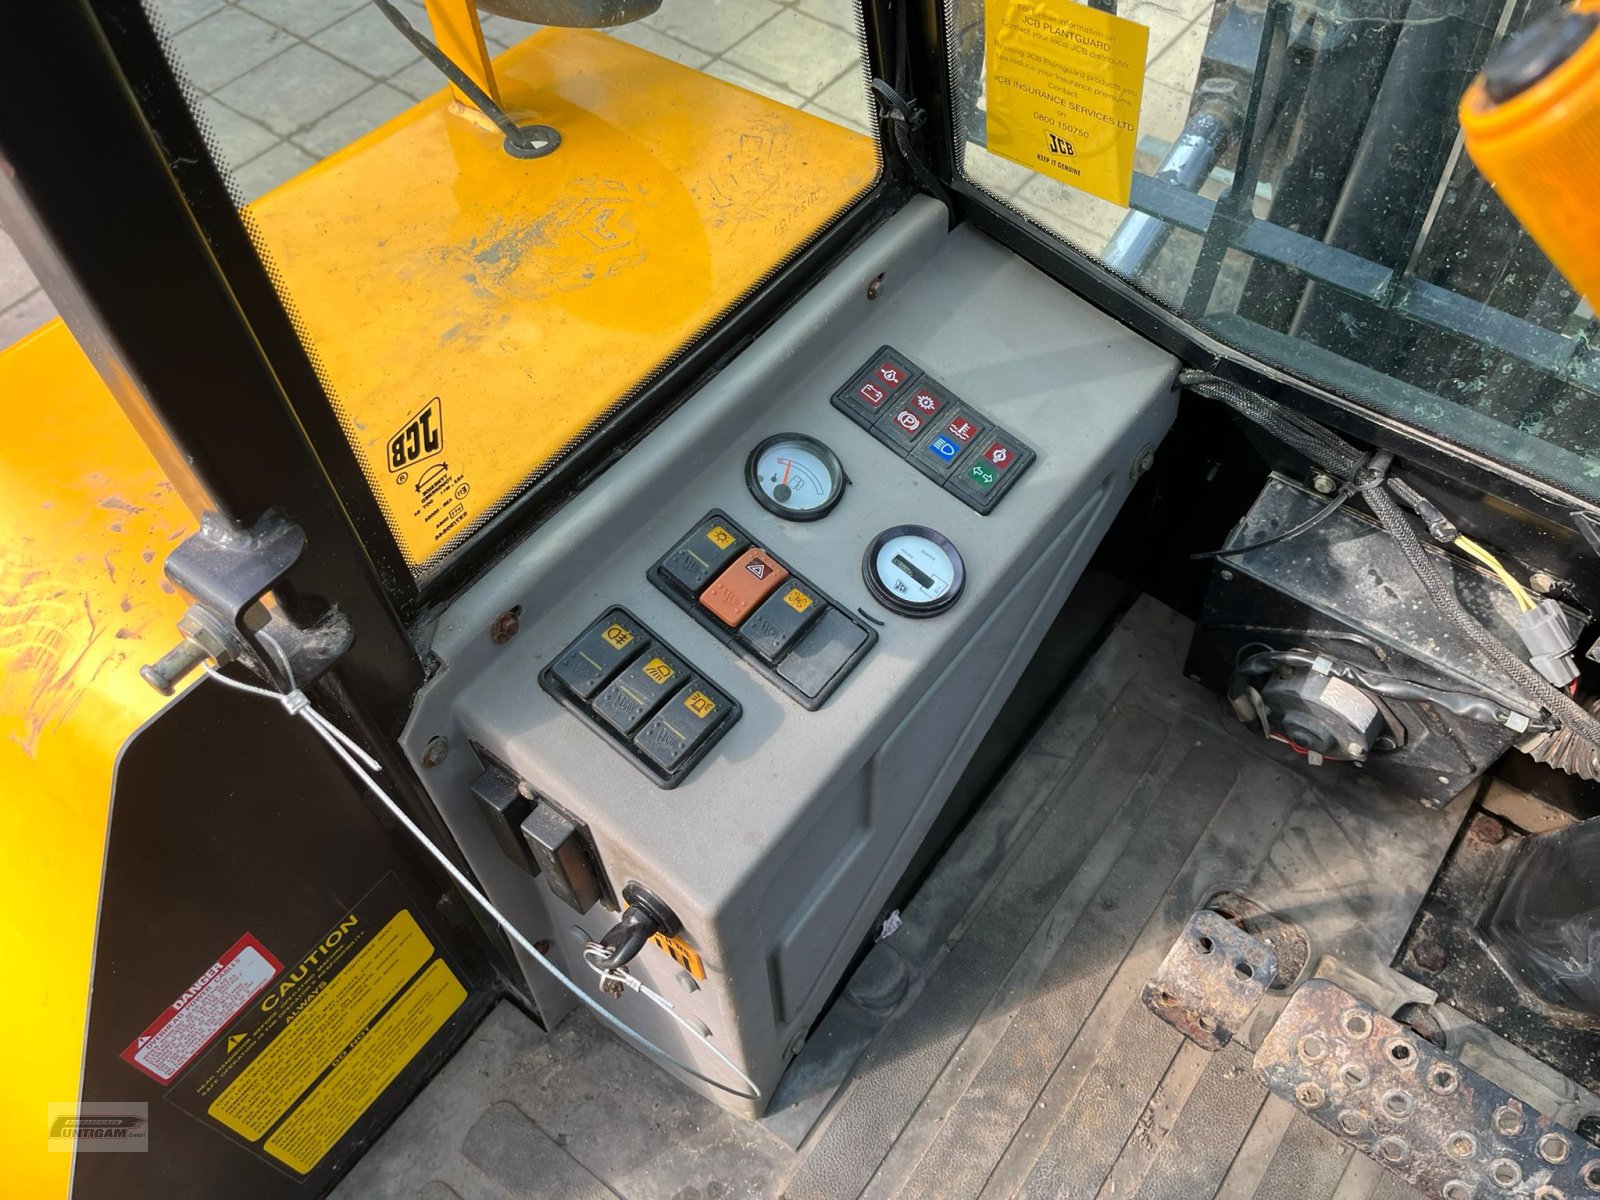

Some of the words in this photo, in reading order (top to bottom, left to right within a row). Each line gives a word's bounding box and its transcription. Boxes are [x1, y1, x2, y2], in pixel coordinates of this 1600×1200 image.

[1002, 18, 1031, 35] Contact
[1032, 31, 1049, 41] your
[1051, 35, 1069, 48] local
[1070, 44, 1088, 56] JCB
[1090, 50, 1130, 69] distributor
[1017, 5, 1030, 15] For
[1031, 8, 1058, 23] further
[1059, 17, 1104, 37] information
[1105, 34, 1116, 42] on
[1022, 16, 1041, 29] JCB
[1044, 24, 1111, 52] PLANTGUARD
[1004, 45, 1024, 58] using
[1026, 52, 1042, 63] JCB
[1043, 58, 1085, 79] Plantguard
[1087, 72, 1121, 91] products
[1123, 86, 1138, 96] you
[1010, 58, 1036, 72] reduce
[1037, 67, 1053, 78] your
[1094, 86, 1133, 107] premiums.
[1048, 82, 1078, 98] Contact
[993, 75, 1011, 86] JCB
[1013, 80, 1066, 107] INSURANCE
[1069, 102, 1115, 125] SERVICES
[1117, 119, 1135, 131] LTD
[1033, 111, 1055, 125] 0800
[1057, 121, 1089, 139] 150750
[1057, 110, 1066, 118] on
[1037, 154, 1050, 164] KEEP
[1057, 162, 1081, 177] GENUINE
[1049, 133, 1075, 156] JCB
[172, 960, 224, 1011] DANGER
[260, 915, 359, 1013] CAUTION
[144, 1012, 184, 1050] OVERHEAD
[184, 984, 212, 1011] POWER
[213, 956, 240, 983] CABLES
[215, 1036, 252, 1074] HANDBOOK
[252, 1009, 277, 1037] BEFORE
[279, 971, 315, 1009] OPERATING
[284, 978, 327, 1024] ALWAYS
[219, 1038, 257, 1078] OPERATION
[331, 1049, 347, 1067] DO
[349, 1025, 369, 1048] NOT
